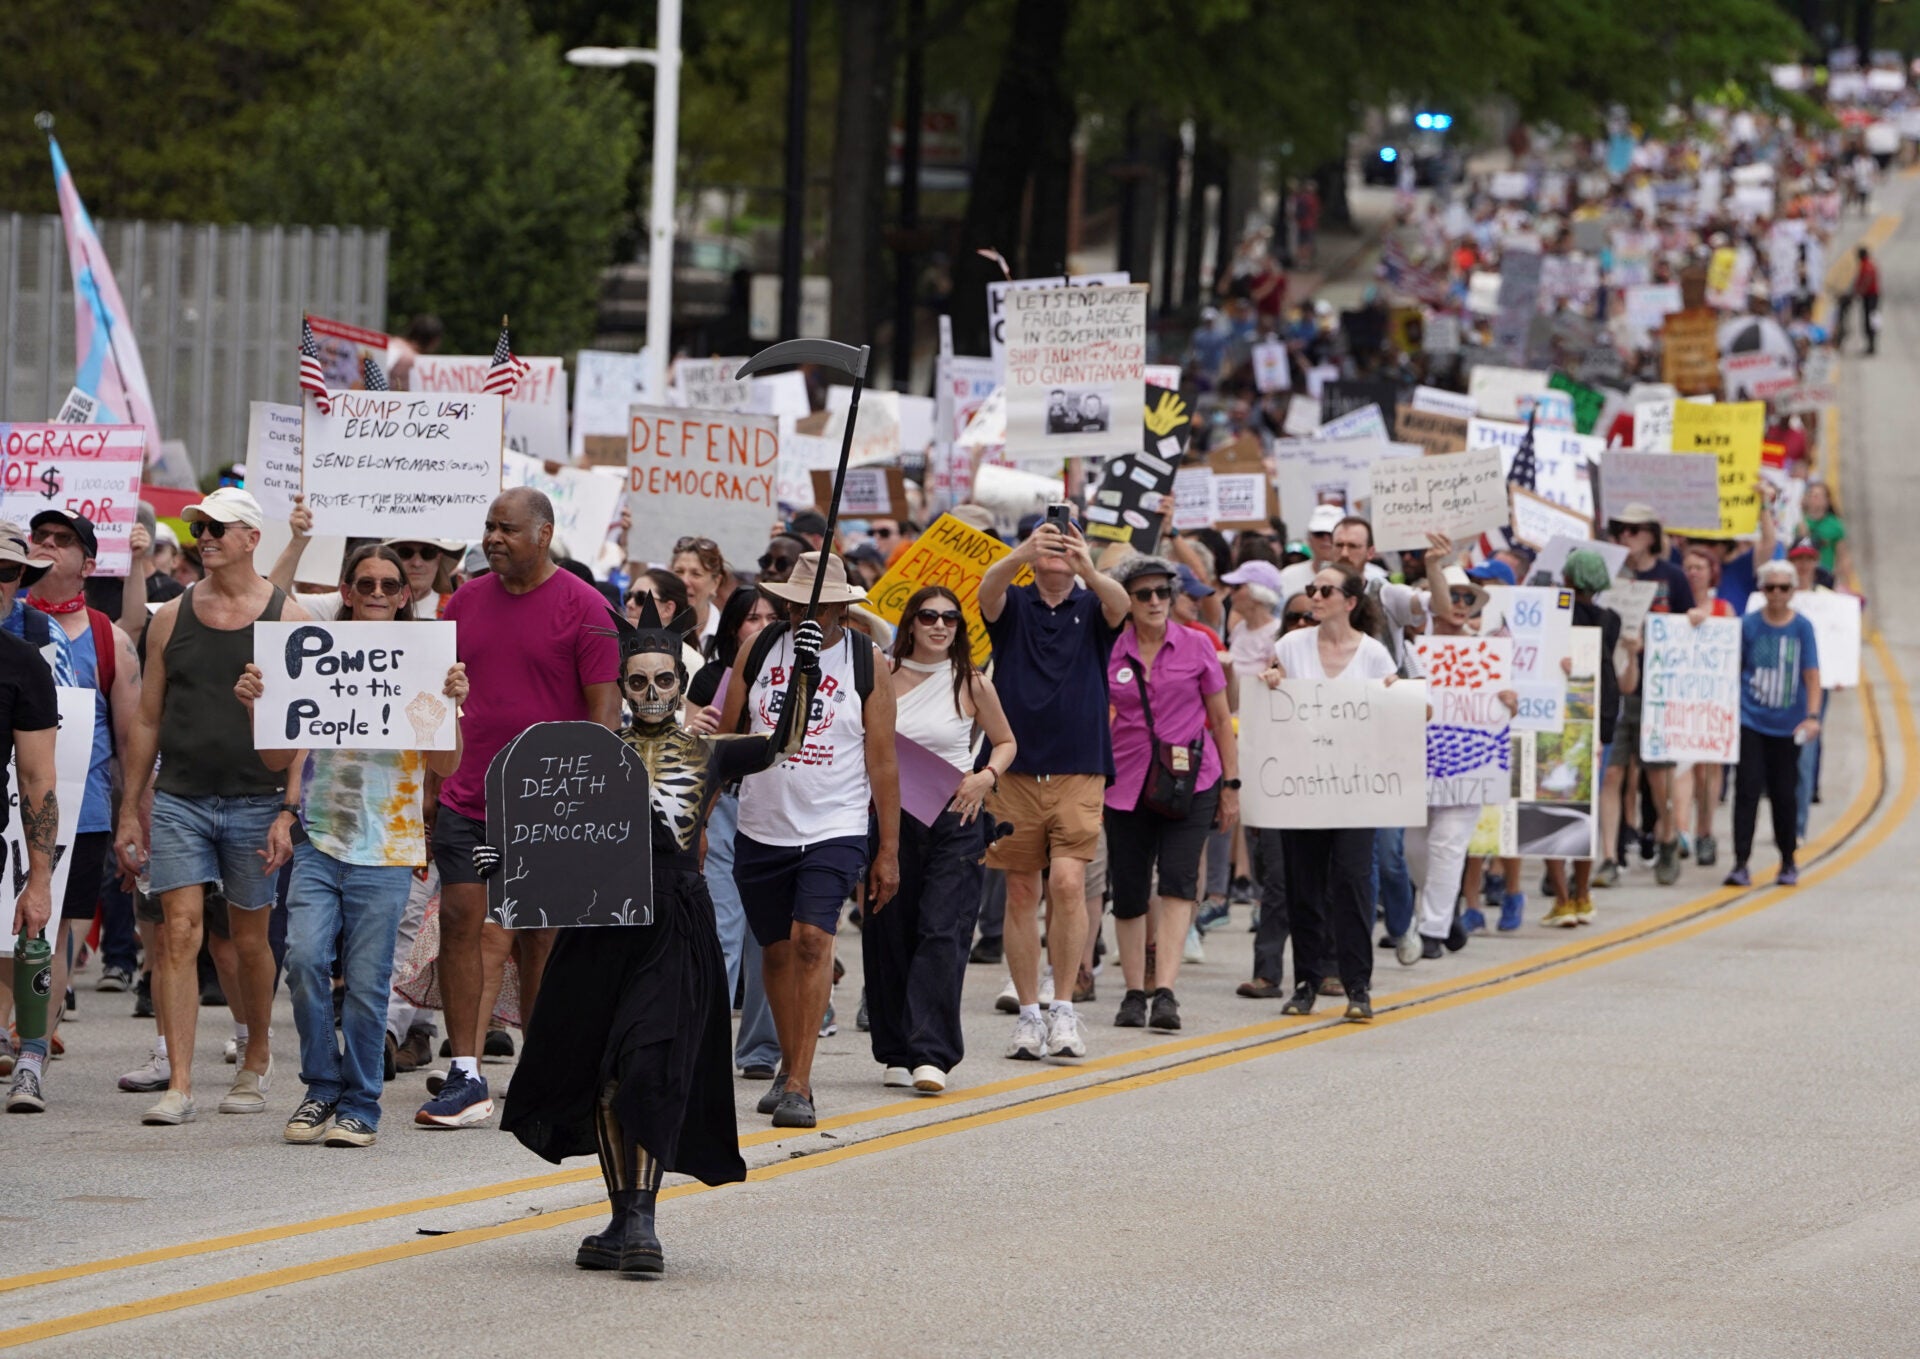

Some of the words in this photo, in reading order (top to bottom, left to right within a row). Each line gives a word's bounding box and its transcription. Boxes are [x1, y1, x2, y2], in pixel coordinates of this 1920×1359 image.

[1023, 331, 1039, 344] IN
[1014, 367, 1036, 384] TO
[1040, 363, 1145, 384] GUANTANAMO
[329, 393, 401, 420] TRUMP
[407, 400, 430, 420] TO
[268, 430, 286, 441] Cut
[344, 418, 399, 440] BEND
[403, 422, 450, 440] OVER
[0, 429, 110, 458] OCRACY
[631, 416, 778, 467] DEFEND
[0, 460, 38, 487] OT
[266, 460, 282, 471] Cut
[313, 452, 354, 469] SEND
[357, 454, 395, 470] ELON
[408, 458, 445, 472] MARS
[264, 477, 280, 488] Cut
[631, 466, 773, 507] DEMOCRACY
[1426, 472, 1472, 497] people
[310, 493, 370, 509] PROTECT
[931, 520, 1001, 566] HANDS
[1513, 600, 1542, 629] 86
[285, 625, 405, 680] Power
[1511, 646, 1538, 672] 47
[1649, 645, 1736, 669] AGAINST
[330, 678, 358, 697] to
[366, 677, 401, 697] the
[1269, 683, 1370, 722] Defend
[1518, 694, 1556, 719] ase
[1312, 735, 1334, 746] the
[539, 754, 592, 775] THE
[520, 775, 606, 799] DEATH
[1259, 757, 1402, 798] Constitution
[1427, 777, 1495, 806] ANIZE
[554, 801, 584, 820] OF
[511, 821, 631, 845] DEMOCRACY
